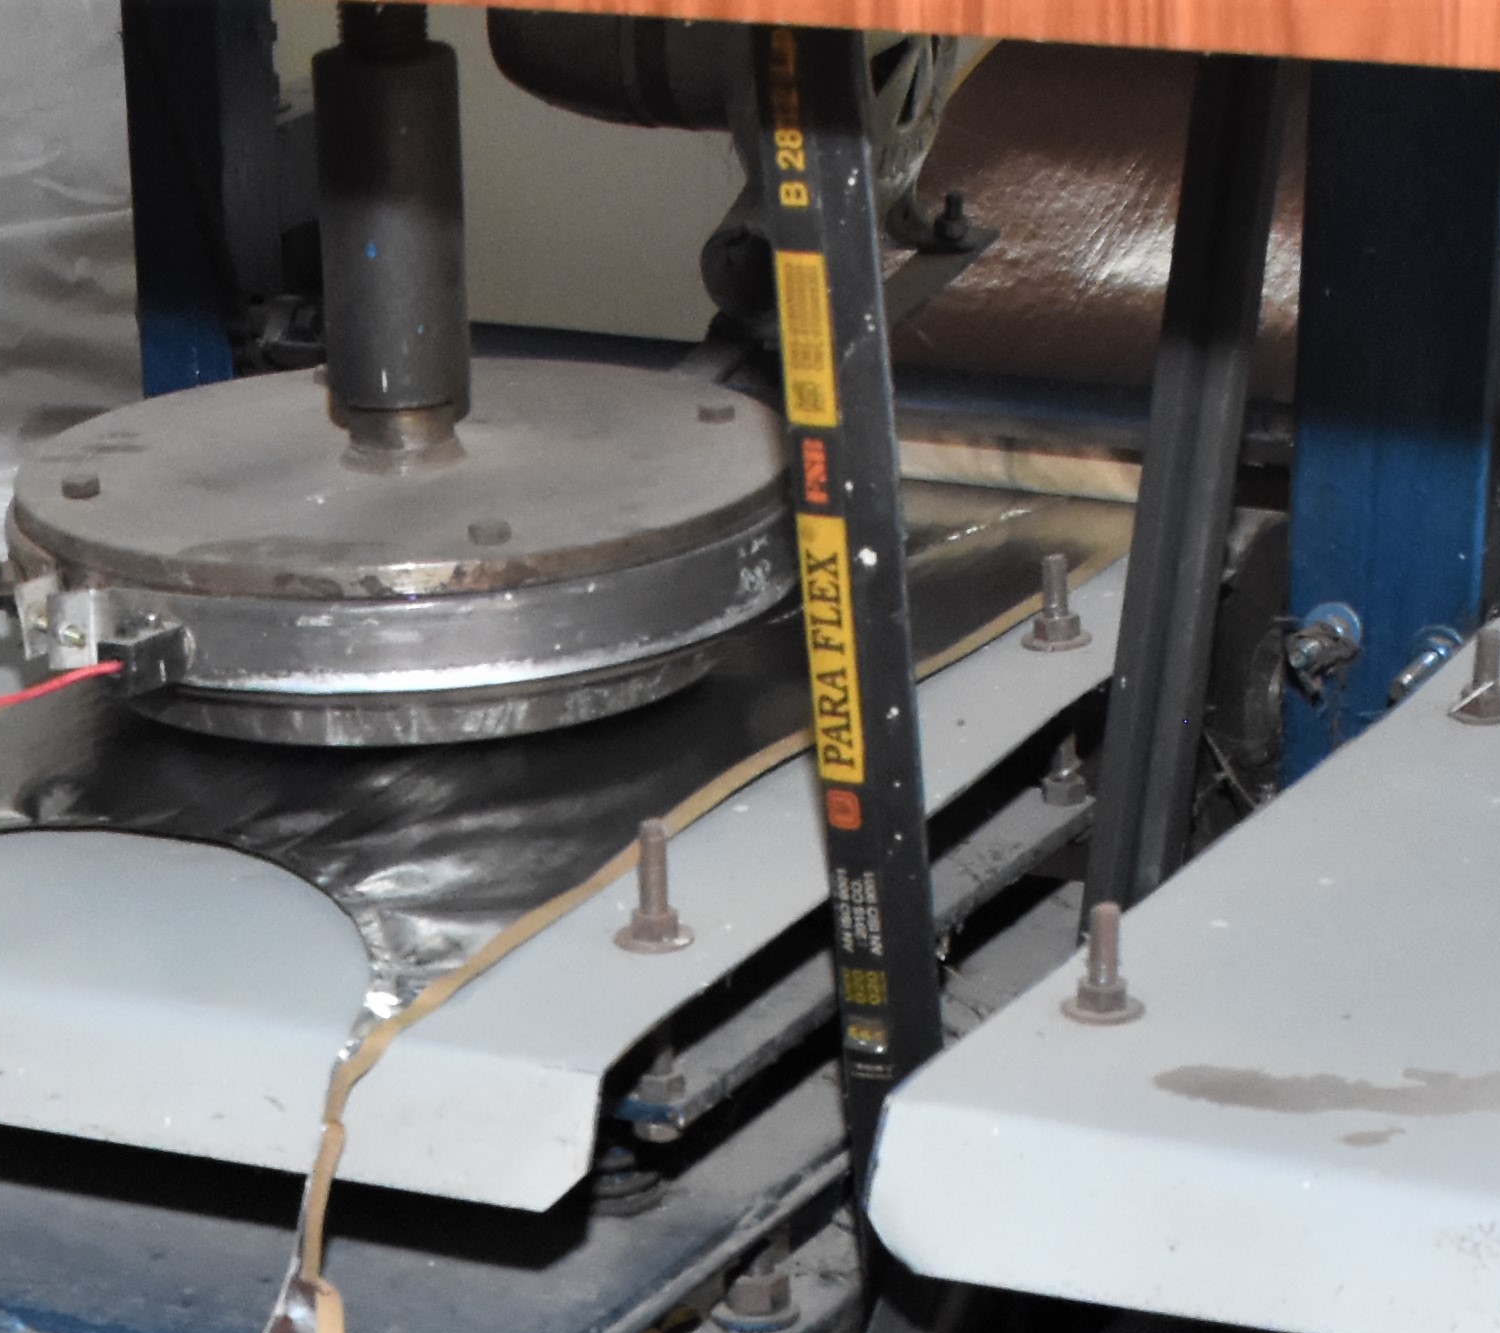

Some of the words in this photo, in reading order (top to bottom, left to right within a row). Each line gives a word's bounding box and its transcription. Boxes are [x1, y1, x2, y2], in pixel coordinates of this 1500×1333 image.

[779, 181, 809, 209] B
[806, 549, 846, 655] FLEX
[816, 667, 855, 769] PARA
